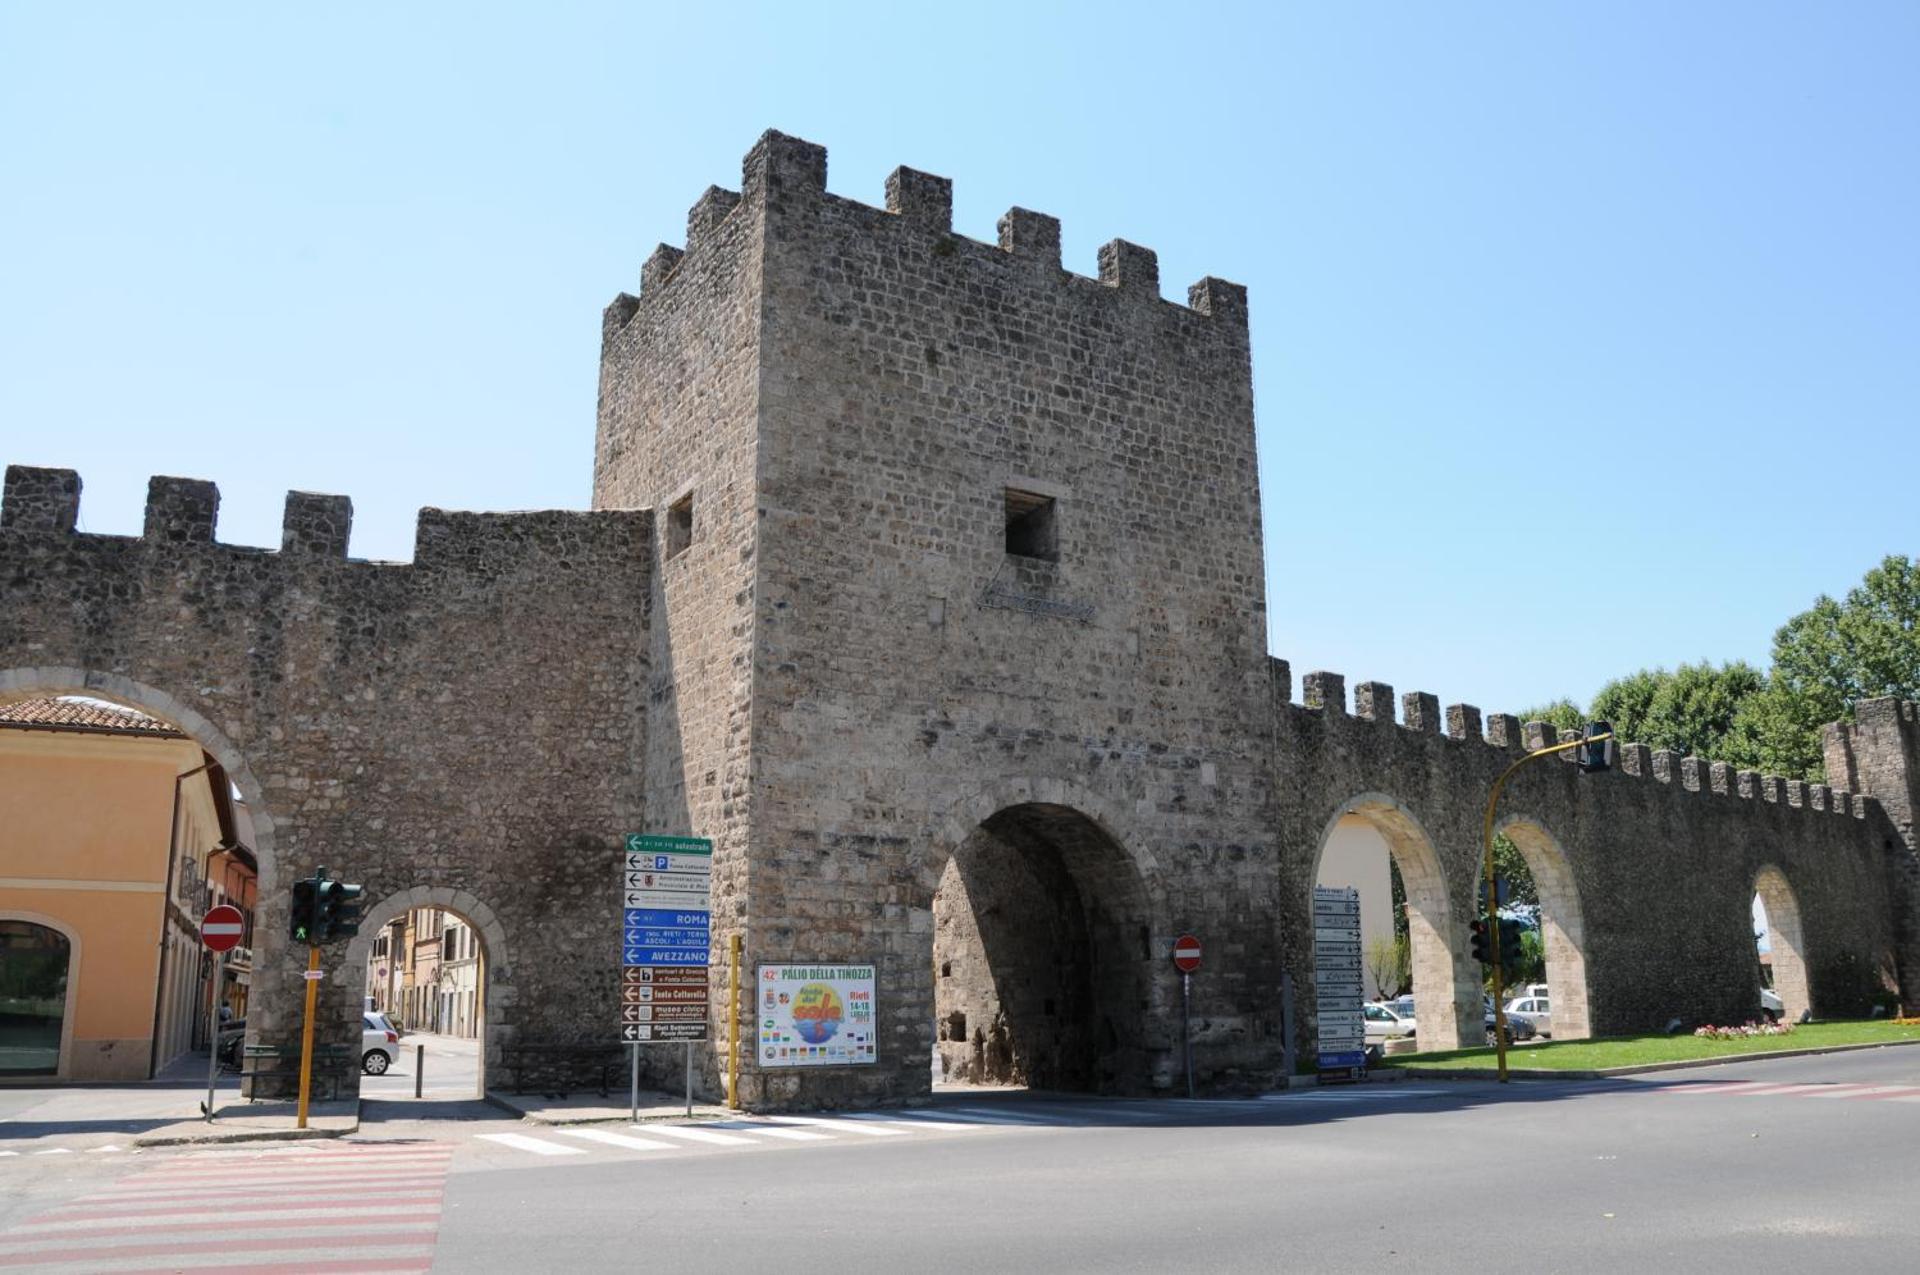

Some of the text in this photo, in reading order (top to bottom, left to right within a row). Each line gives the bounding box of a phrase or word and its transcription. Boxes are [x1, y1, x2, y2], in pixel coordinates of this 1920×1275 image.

[657, 858, 667, 869] P
[677, 915, 708, 925] ROMA
[676, 938, 708, 946] L'AQUILA
[651, 951, 707, 961] AVEZZANO
[782, 968, 807, 980] PALIO
[810, 968, 835, 980] DELLA
[837, 968, 872, 980] TINOZZA
[683, 1006, 706, 1014] civico
